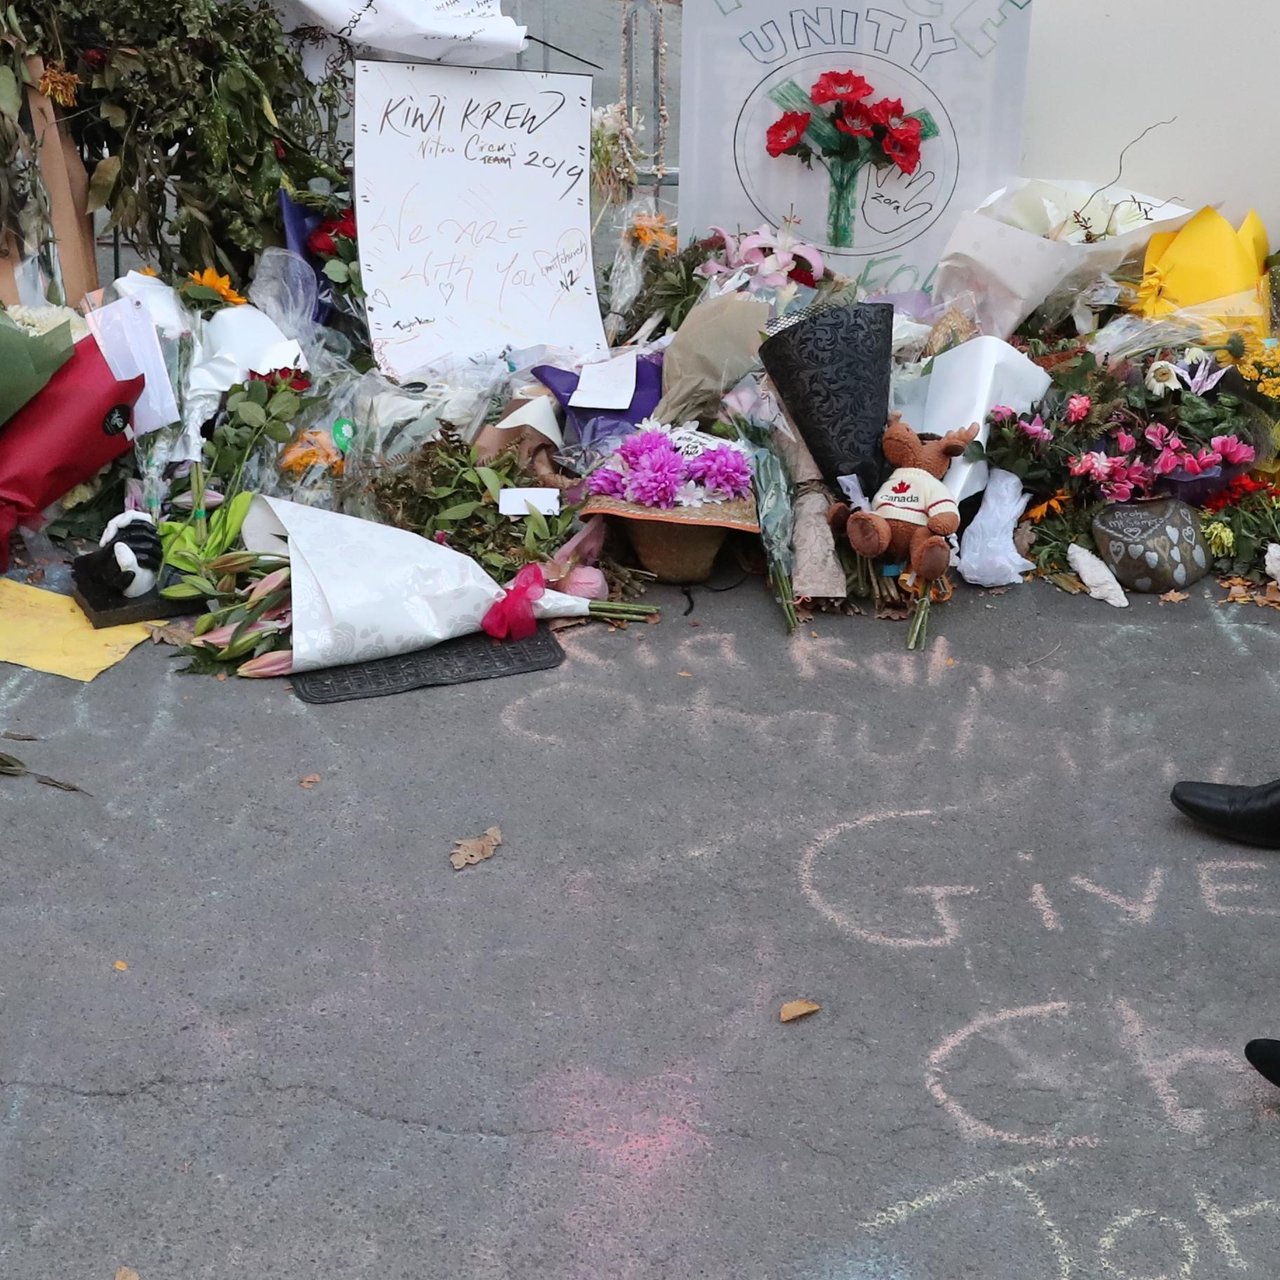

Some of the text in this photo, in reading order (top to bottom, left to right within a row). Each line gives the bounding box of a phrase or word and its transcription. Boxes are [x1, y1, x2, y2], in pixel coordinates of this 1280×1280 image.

[738, 6, 958, 72] UNITY
[459, 90, 566, 135] KREW
[418, 135, 456, 160] Nitro
[479, 154, 512, 170] TEAM
[523, 150, 585, 201] 2019
[880, 494, 920, 503] Canada
[1115, 510, 1150, 520] Aroha
